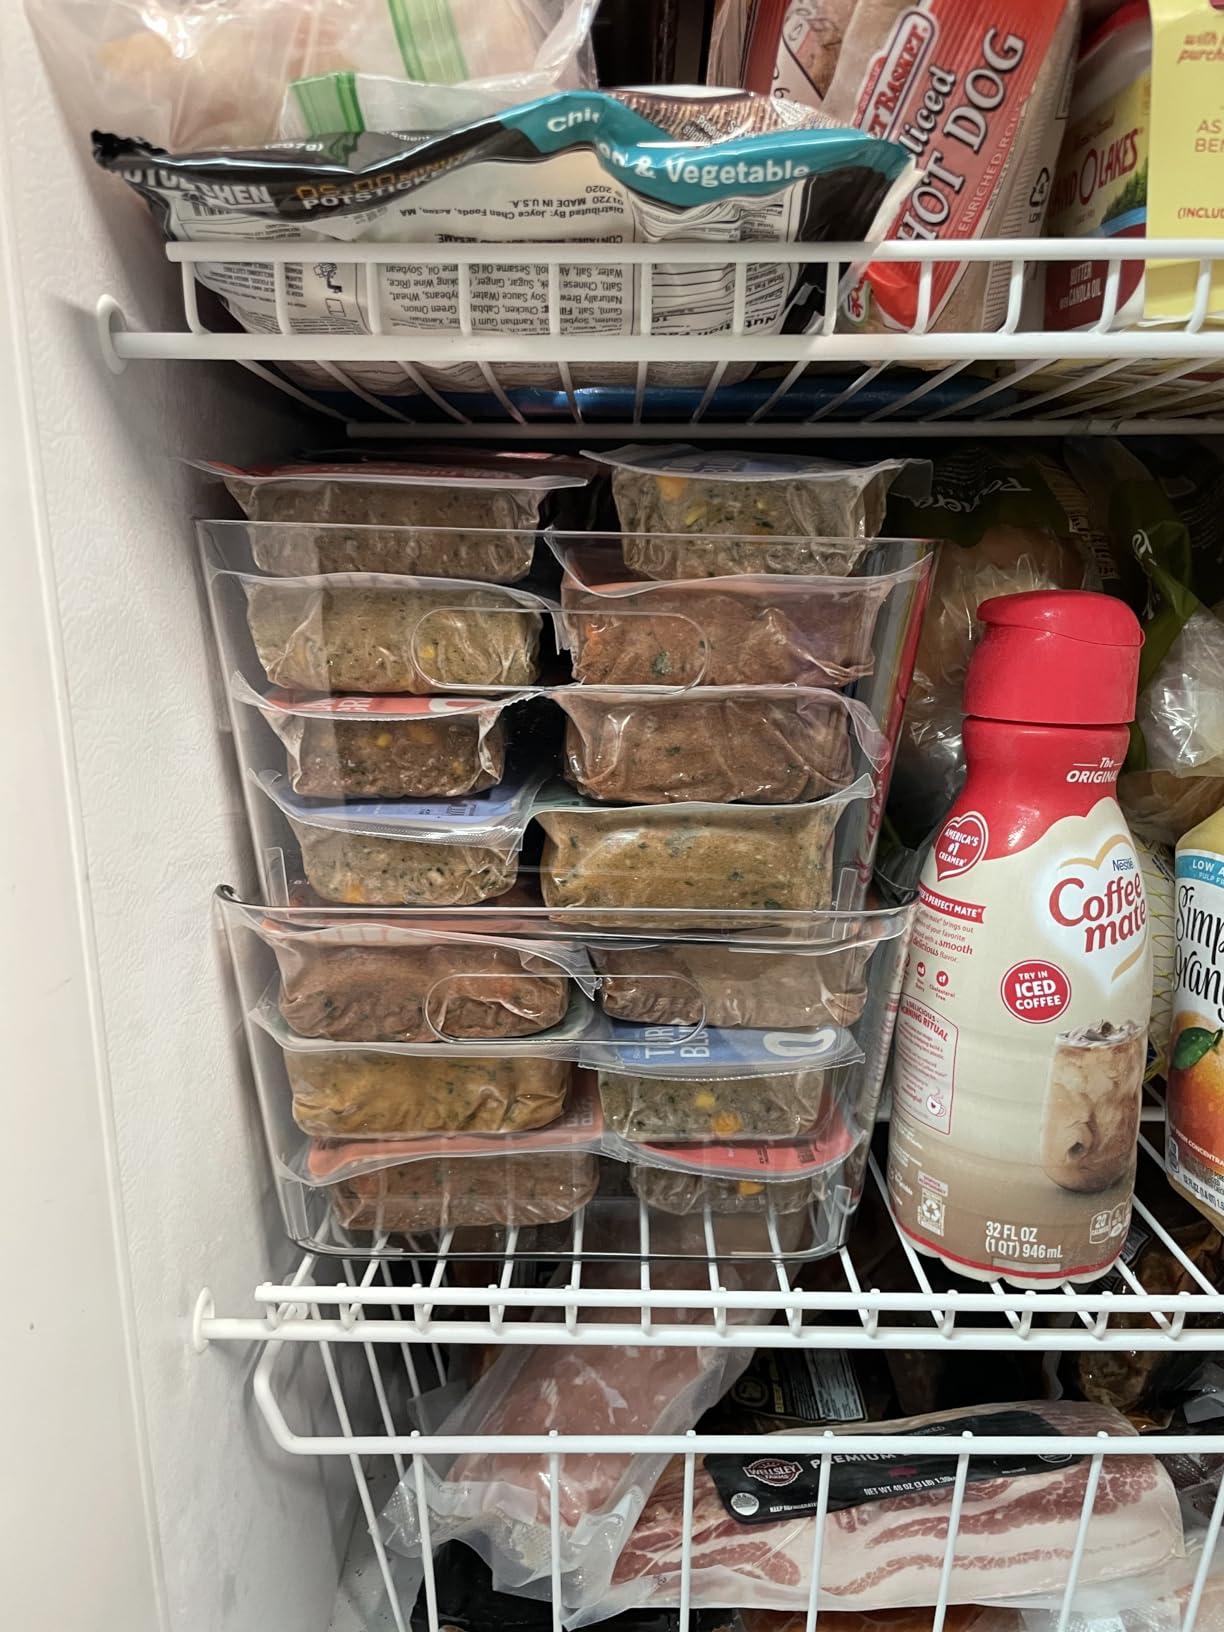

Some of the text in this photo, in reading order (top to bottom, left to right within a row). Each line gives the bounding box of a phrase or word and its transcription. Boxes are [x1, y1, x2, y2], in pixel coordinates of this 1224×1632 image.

[898, 64, 956, 155] liced
[1197, 120, 1222, 134] AS
[896, 26, 1026, 240] HOT DOG
[1097, 128, 1139, 189] LAKES
[634, 155, 657, 179] &
[665, 158, 811, 187] Vegetable
[958, 153, 1002, 232] ENRICHED
[556, 198, 586, 208] MADE
[400, 208, 416, 216] MA
[454, 208, 487, 216] Foods,
[490, 210, 514, 220] Chen
[518, 209, 546, 218] Joyce
[551, 210, 566, 218] By:
[569, 207, 624, 218] Distributed
[386, 266, 422, 276] Soybean
[426, 265, 440, 276] Oil,
[481, 265, 493, 274] Oil
[496, 265, 530, 276] Sesame
[573, 266, 592, 278] Salt,
[596, 267, 623, 278] Water,
[387, 278, 410, 289] (Rice,
[413, 279, 434, 288] Wine
[474, 277, 505, 288] Ginger,
[507, 278, 534, 290] Sugar,
[563, 282, 597, 292] Chinese
[600, 282, 622, 292] Salt),
[389, 292, 420, 302] Wheat,
[422, 291, 459, 302] oybeans,
[502, 292, 528, 302] Sauce
[531, 292, 546, 303] Soy
[584, 294, 622, 304] Naturally
[400, 305, 429, 315] Onion,
[431, 305, 457, 314] Green
[504, 305, 539, 315] Chicken,
[598, 307, 622, 316] Gum),
[479, 319, 498, 327] Gum
[1100, 757, 1115, 769] The
[1065, 769, 1118, 784] ORIGINA
[944, 828, 980, 847] AMERICA'S
[947, 841, 959, 854] #1
[938, 850, 967, 867] CREAMER
[1192, 858, 1216, 873] LOW
[927, 892, 955, 913] PERFECT
[953, 903, 979, 918] MATE
[1049, 872, 1142, 928] Coffee
[941, 918, 959, 932] brings
[959, 922, 974, 934] out
[1084, 900, 1147, 953] mate
[941, 928, 967, 943] favorite
[938, 938, 974, 956] smooth
[1017, 970, 1049, 981] TRY IN
[1014, 979, 1057, 997] ICED
[1015, 995, 1062, 1011] COFFEE
[922, 1016, 949, 1042] RITUAL
[645, 1025, 676, 1060] TUR
[680, 1026, 711, 1058] BLU
[985, 1221, 1038, 1244] 32 FL OZ
[985, 1237, 998, 1256] (1
[997, 1239, 1020, 1259] QT)
[909, 1425, 946, 1436] MOKED
[748, 1465, 797, 1477] WELLSLEY
[864, 1487, 879, 1497] NET
[878, 1485, 892, 1495] WT
[902, 1482, 914, 1490] OZ
[922, 1478, 935, 1488] LB)
[769, 1505, 783, 1513] KEEP
